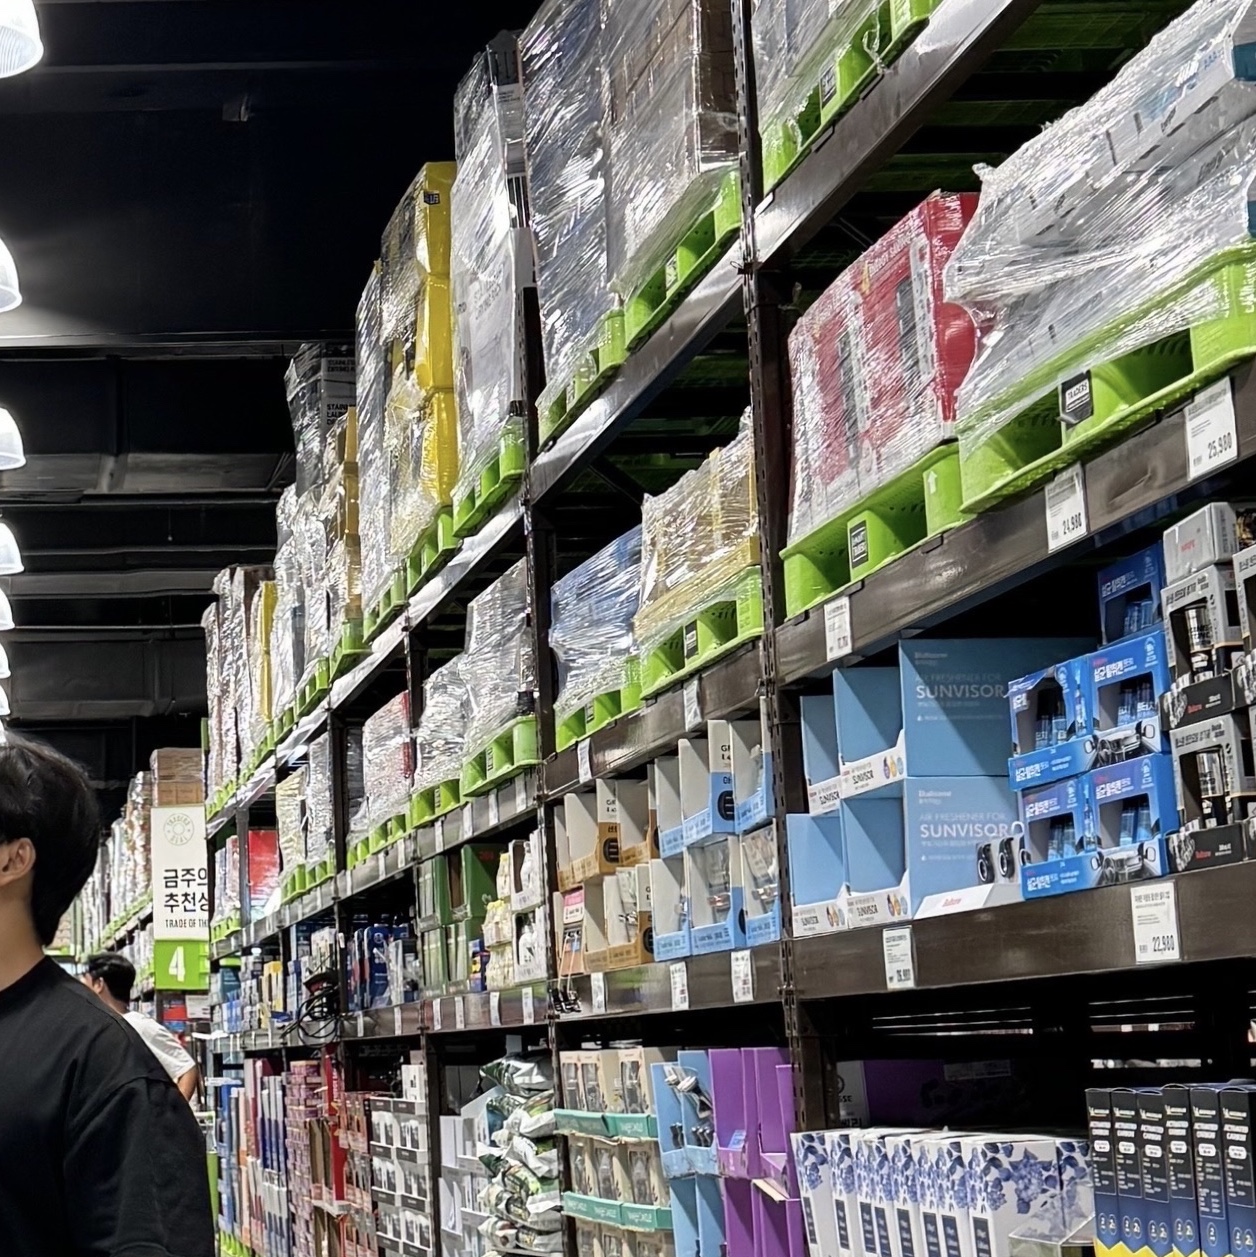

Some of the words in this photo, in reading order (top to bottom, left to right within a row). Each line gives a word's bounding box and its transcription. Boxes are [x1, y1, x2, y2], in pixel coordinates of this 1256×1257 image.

[1208, 432, 1232, 460] 25,980
[916, 684, 1004, 699] SUNVISOR
[919, 823, 1008, 838] SUNVISOR
[165, 919, 187, 928] TRADE
[188, 919, 197, 928] OF
[168, 945, 186, 983] 4
